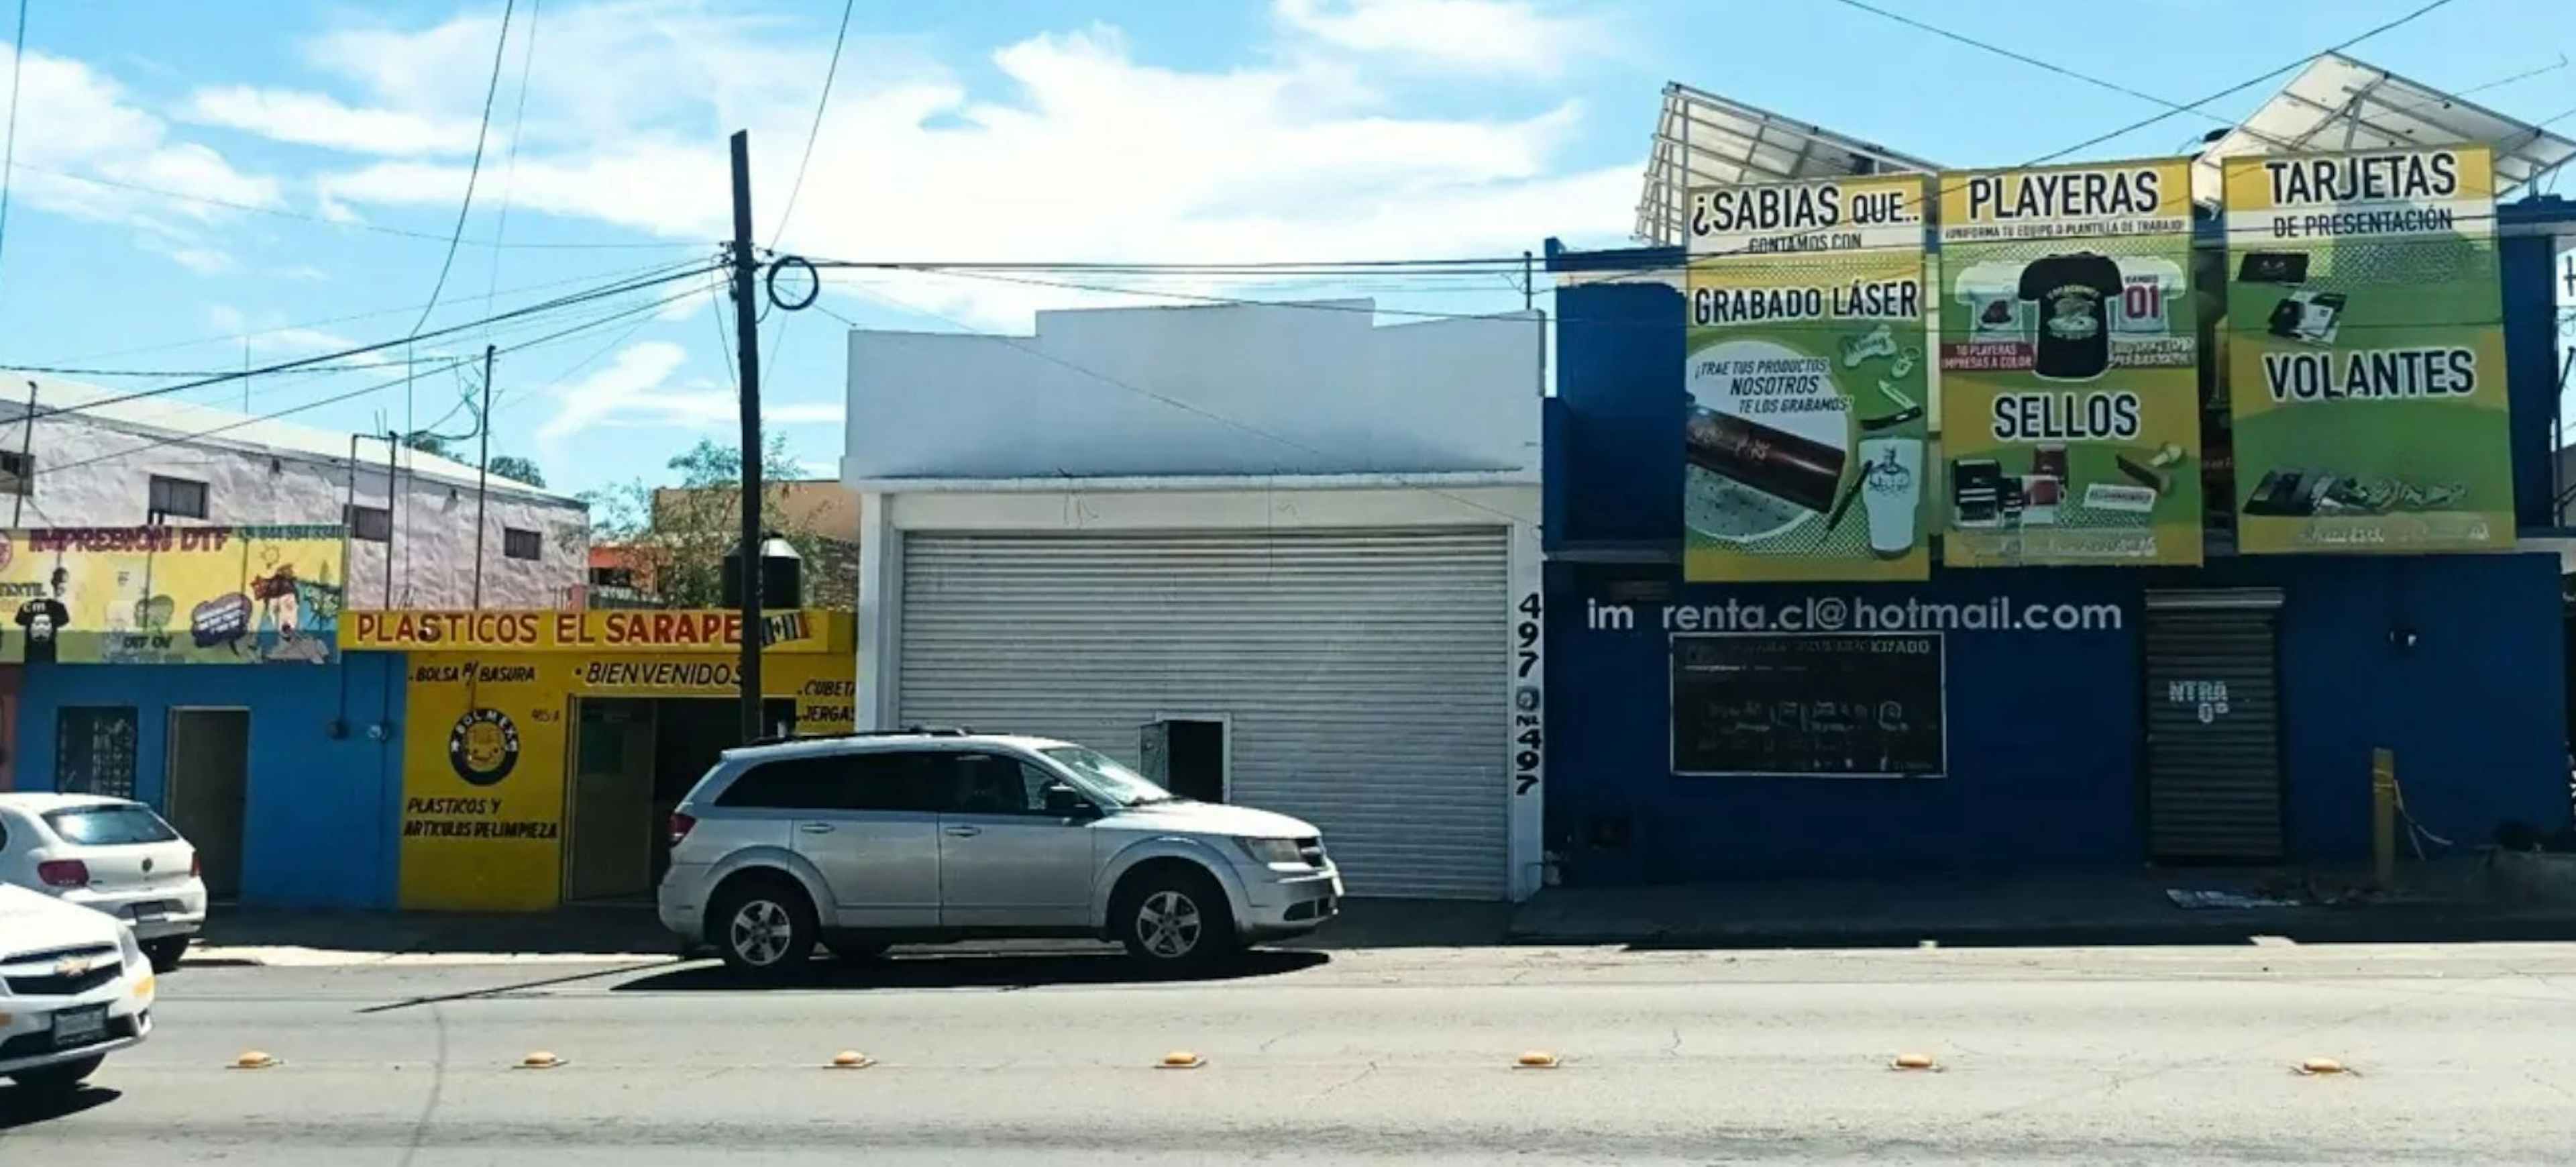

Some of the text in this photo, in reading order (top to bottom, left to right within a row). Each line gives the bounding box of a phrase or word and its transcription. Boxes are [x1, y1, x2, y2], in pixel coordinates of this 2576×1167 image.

[2266, 154, 2455, 203] TARJETAS
[1970, 171, 2158, 220] PLAYERAS
[1693, 186, 1839, 236] ¿SABIAS
[2273, 205, 2453, 238] DE PRESENTACIÓN
[1748, 233, 1862, 253] CONTAMOS CON
[2017, 224, 2053, 237] EQUIPO
[2065, 221, 2120, 235] PLANTILLA
[2121, 221, 2133, 232] DE
[1695, 279, 1917, 323] GRABADO LÁSER
[2126, 285, 2159, 319] 01
[1733, 360, 1754, 375] TUS
[1756, 358, 1828, 374] PRODUCTOS
[2265, 350, 2474, 399] VOLANTES
[1730, 375, 1820, 396] NOSOTROS
[1739, 399, 1752, 413] TE
[1754, 399, 1778, 413] LOS
[1994, 394, 2138, 438] SELLOS
[179, 526, 233, 551] DTF
[357, 613, 742, 643] PLASTICOS EL SARAPE
[1518, 592, 1542, 678] 497
[416, 665, 460, 682] BOLSA
[478, 666, 535, 682] BASURA
[585, 662, 742, 685] BIENVENIDOS
[1516, 728, 1542, 796] 497
[407, 797, 502, 814] PLASTICOS Y
[403, 820, 472, 837] ARTICULOS
